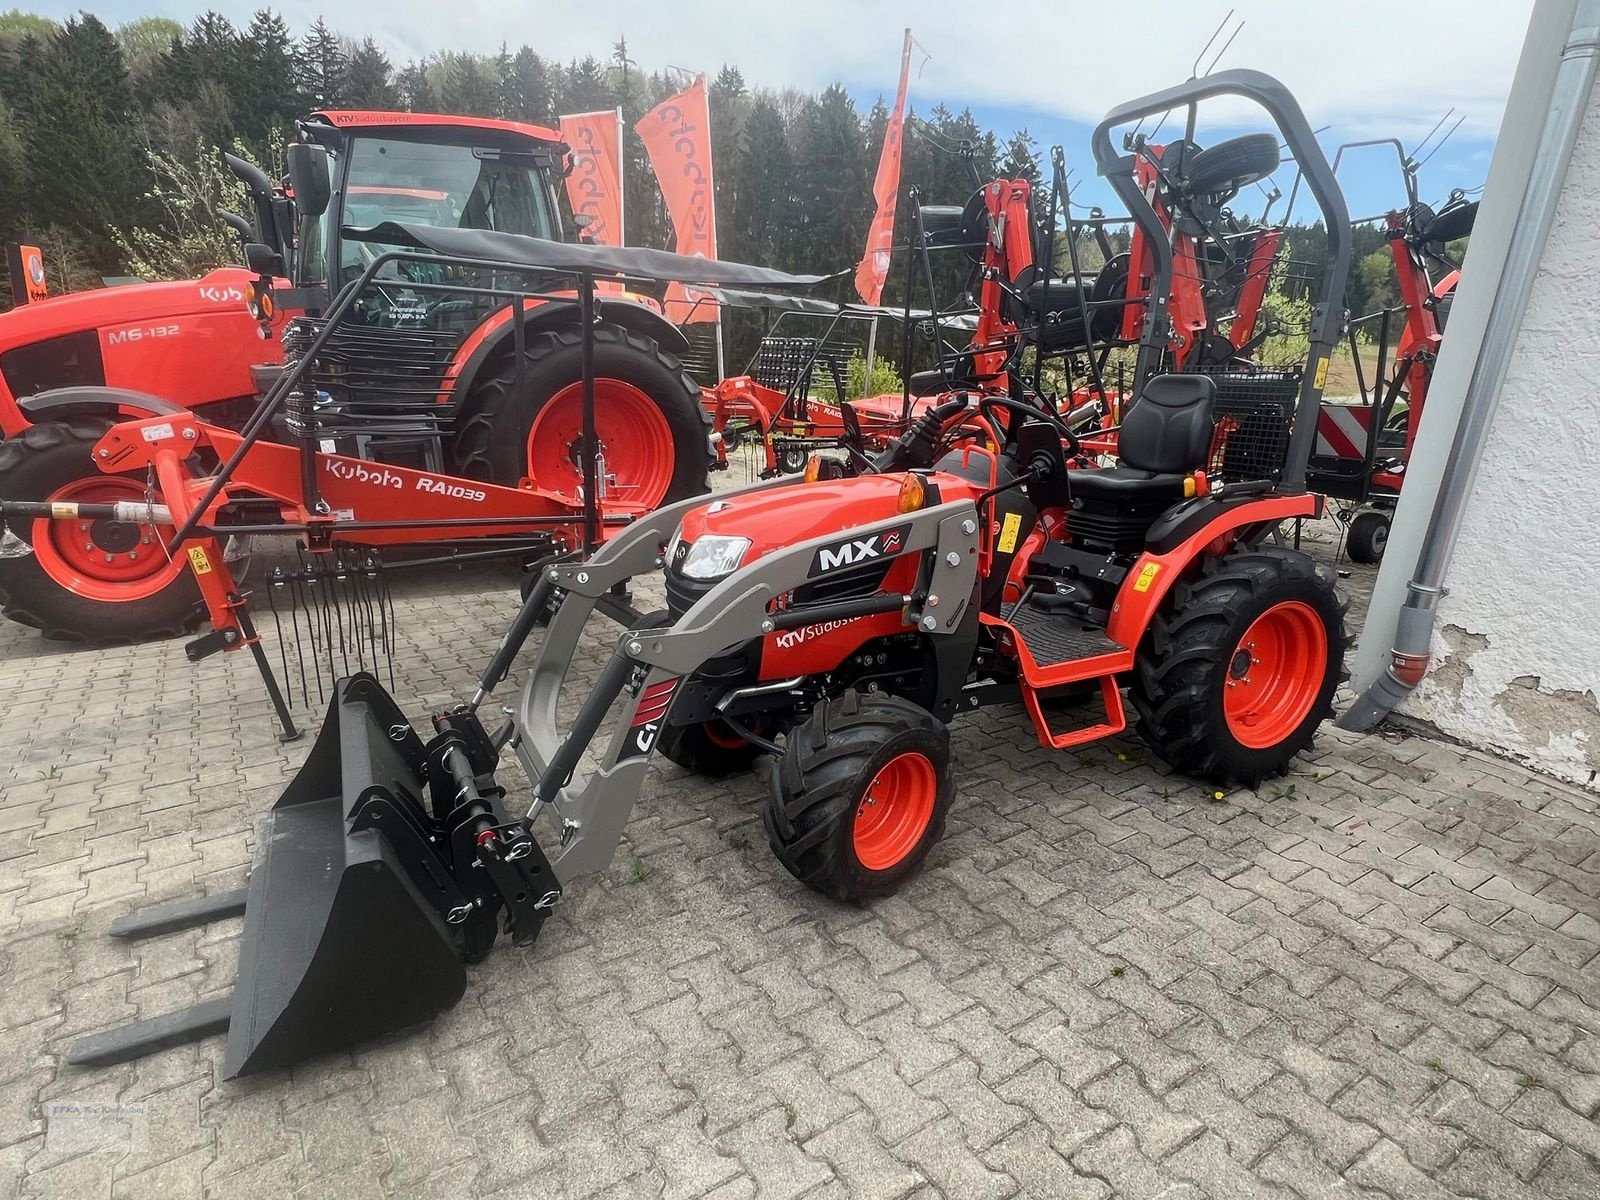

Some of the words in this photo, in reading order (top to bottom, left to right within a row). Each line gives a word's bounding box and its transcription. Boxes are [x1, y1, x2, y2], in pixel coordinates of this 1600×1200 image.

[200, 287, 243, 301] Kub
[108, 325, 180, 345] M6-132
[325, 459, 403, 489] Kubota
[416, 477, 486, 501] RA1039
[819, 535, 880, 571] MX
[775, 627, 806, 648] KTV
